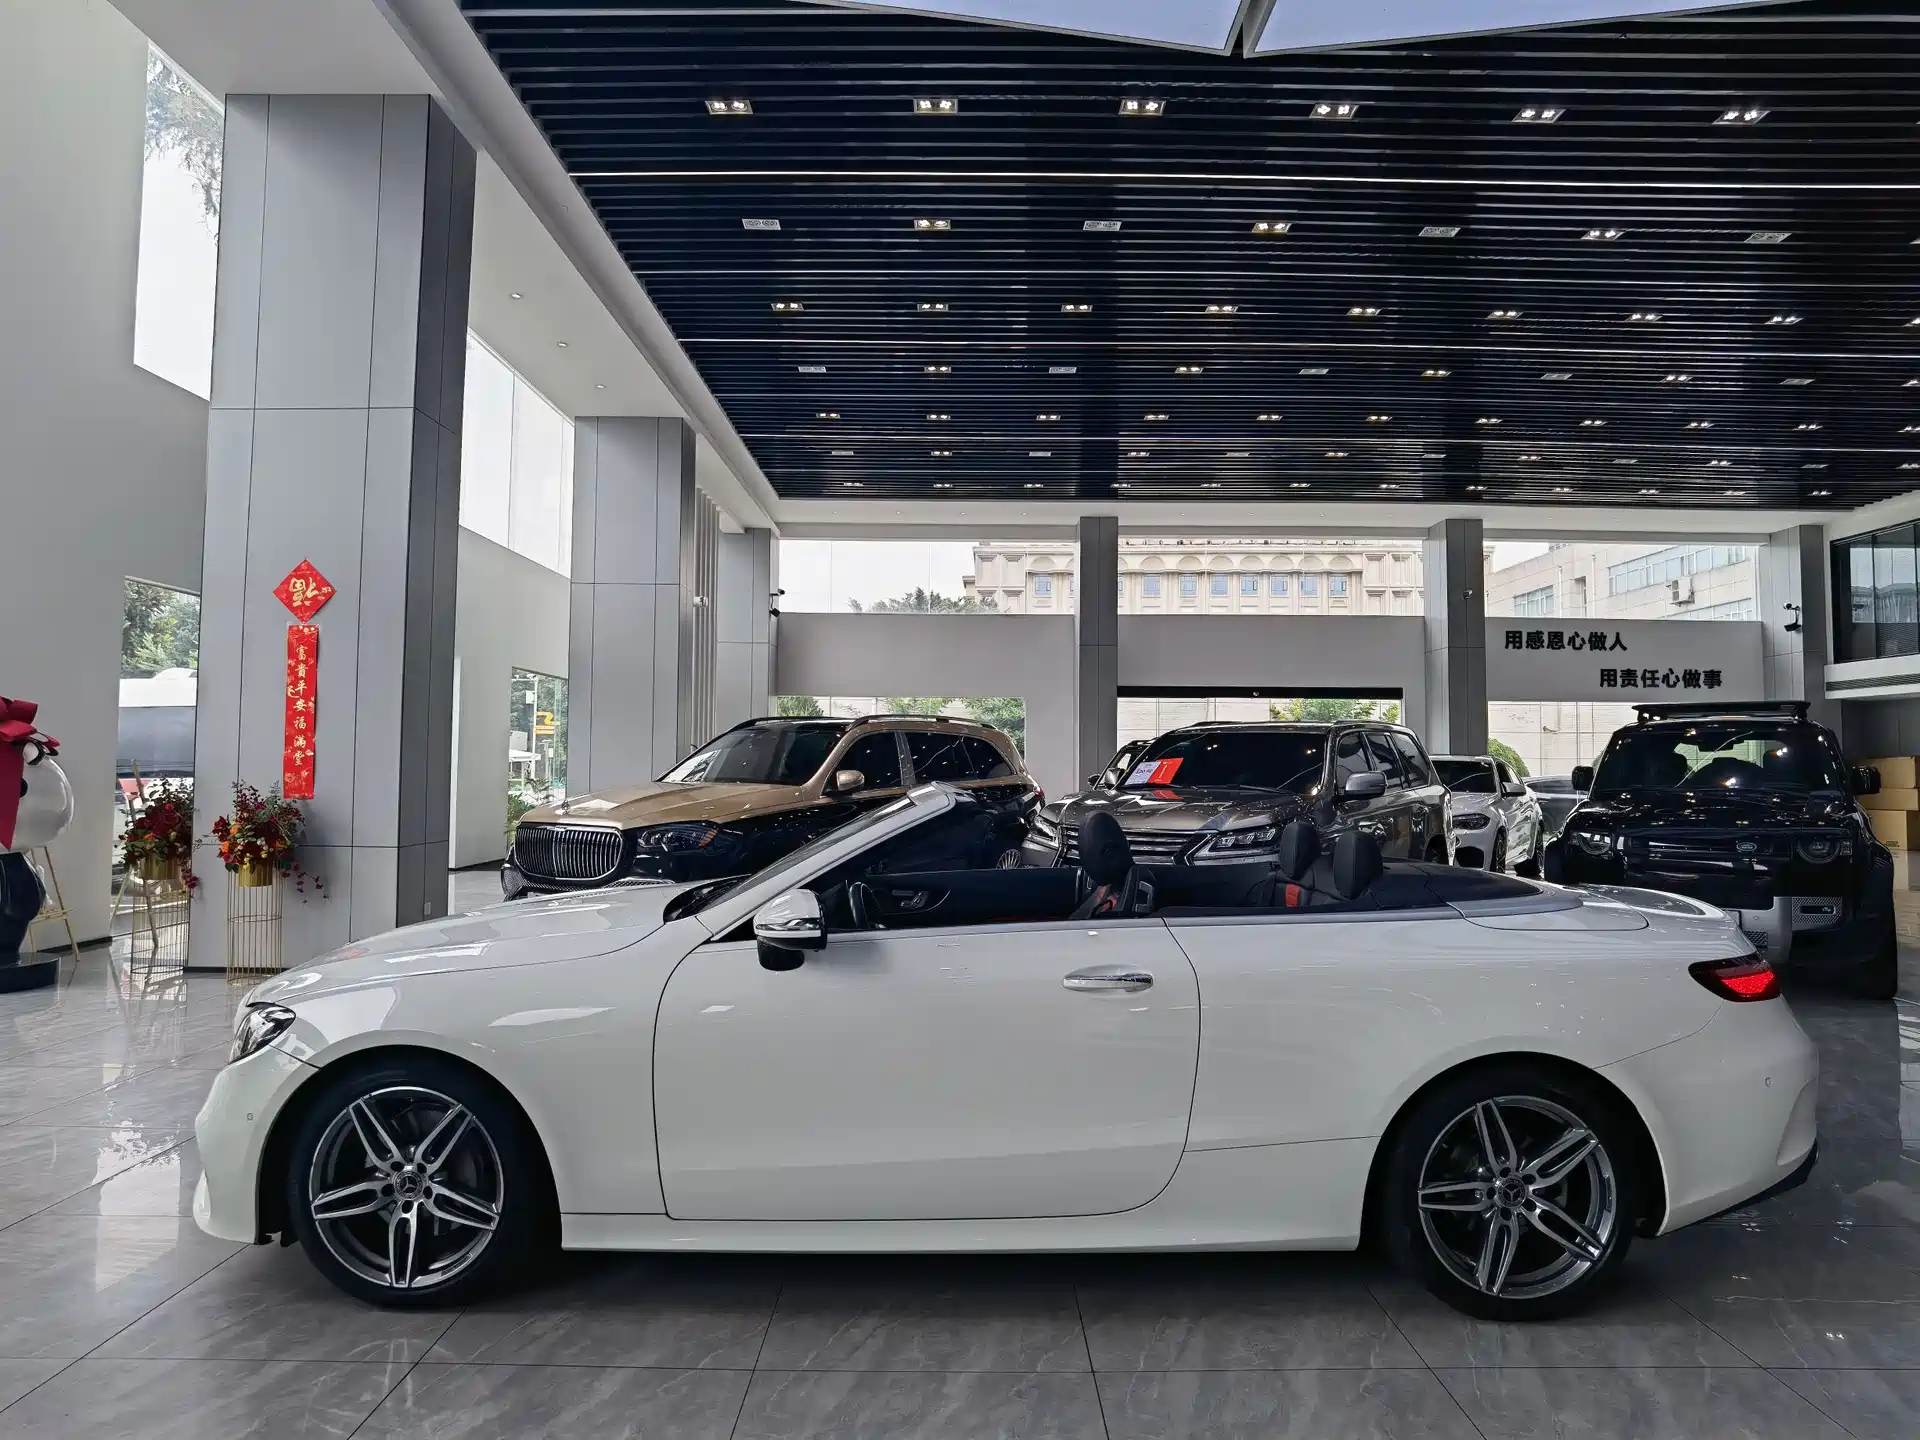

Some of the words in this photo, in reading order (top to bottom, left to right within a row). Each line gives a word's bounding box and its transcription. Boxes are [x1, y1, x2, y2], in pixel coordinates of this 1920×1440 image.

[1504, 630, 1628, 652] 用感恩心做人
[1599, 668, 1723, 689] 用责任心做事
